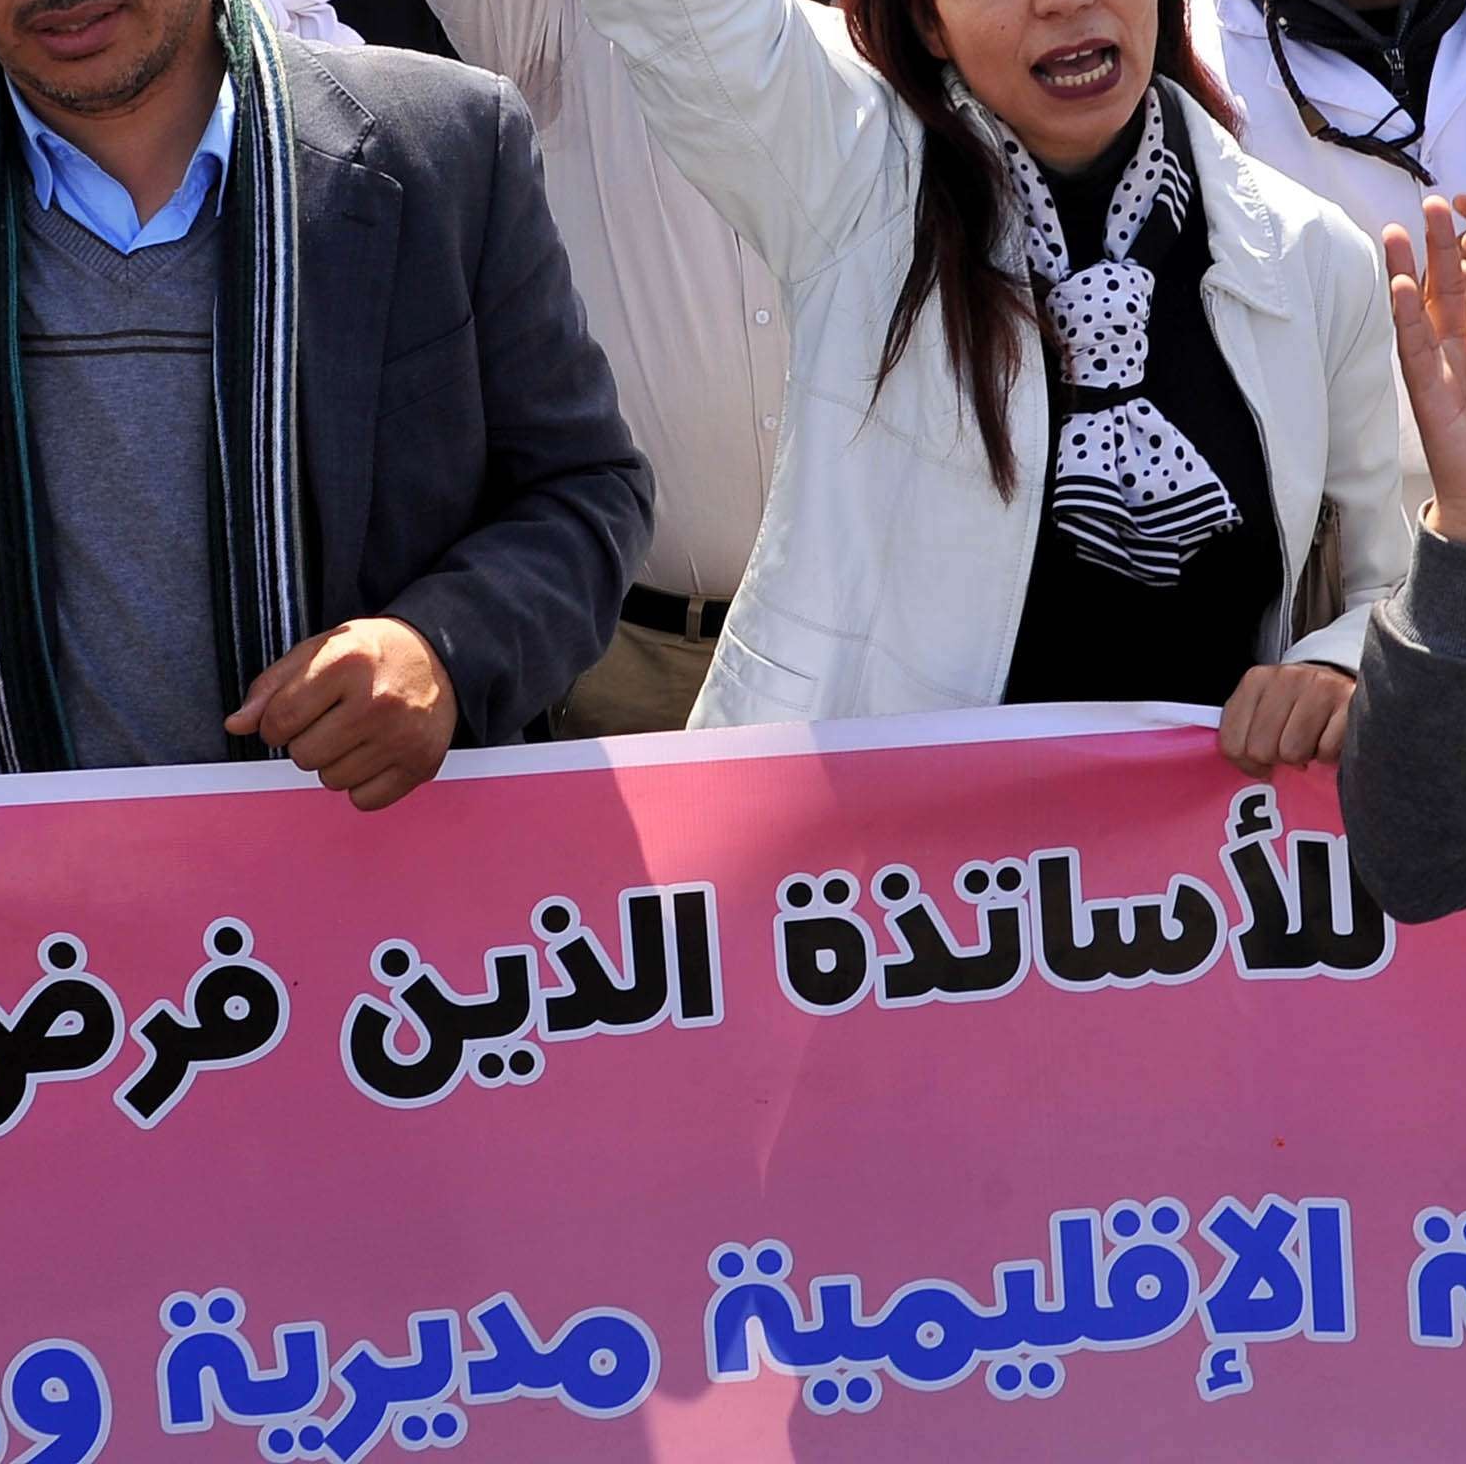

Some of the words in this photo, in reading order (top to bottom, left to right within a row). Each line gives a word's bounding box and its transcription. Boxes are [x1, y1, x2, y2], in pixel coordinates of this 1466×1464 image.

[347, 888, 717, 1102] الذين
[162, 1294, 656, 1464] مديرية
[709, 1200, 1351, 1411] الإقليمية
